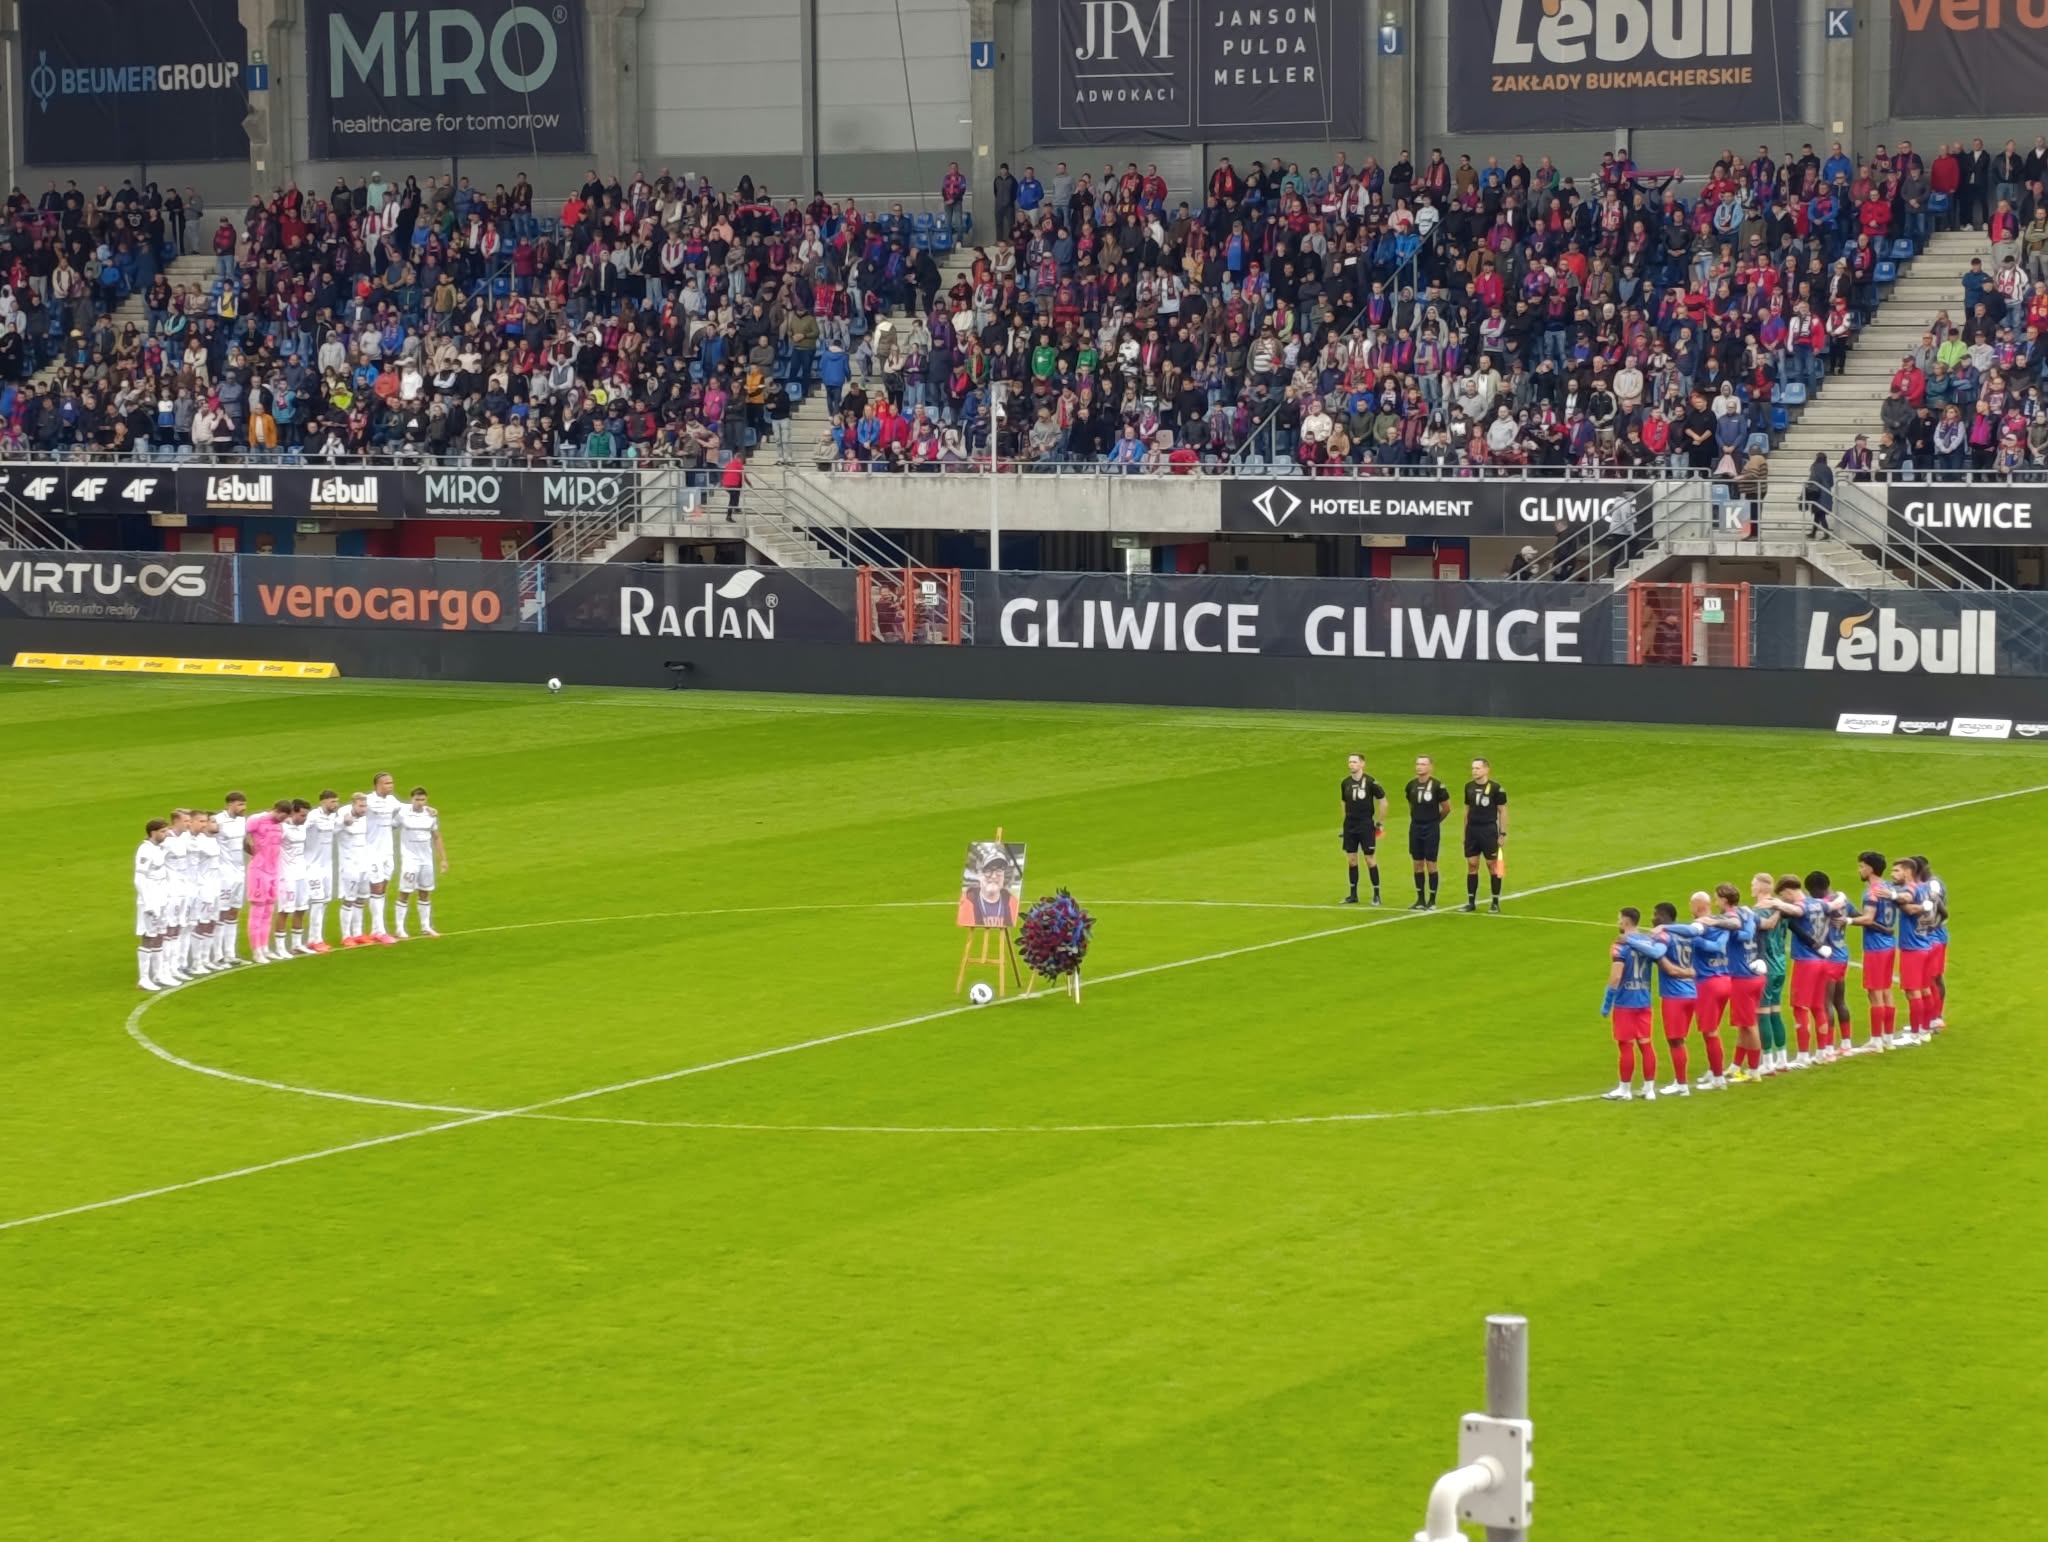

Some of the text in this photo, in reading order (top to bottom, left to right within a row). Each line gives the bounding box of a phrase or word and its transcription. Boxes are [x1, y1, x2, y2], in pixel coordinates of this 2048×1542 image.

[1214, 7, 1316, 27] JANSON
[1828, 10, 1849, 36] K
[1074, 0, 1174, 61] JPM
[1383, 28, 1397, 53] J
[976, 43, 989, 67] J
[1223, 37, 1306, 56] PULDA
[1214, 66, 1315, 86] MELLER
[1492, 67, 1753, 92] ZAKŁADY BUKMACHERSKIE
[1076, 88, 1175, 103] ADWOKACI
[332, 112, 560, 133] healthcare for tomorrow
[23, 477, 59, 500] 4F
[71, 478, 108, 501] 4F
[121, 479, 159, 502] 4F
[682, 492, 695, 513] J
[1310, 498, 1473, 516] HOTELE DIAMENT
[1520, 497, 1637, 523] GLIWIC
[1725, 507, 1743, 529] K
[1904, 501, 2032, 529] GLIWICE
[48, 600, 80, 614] Vision
[257, 583, 500, 631] verocargo
[1000, 597, 1261, 654] GLIWICE
[1304, 604, 1583, 663] GLIWICE
